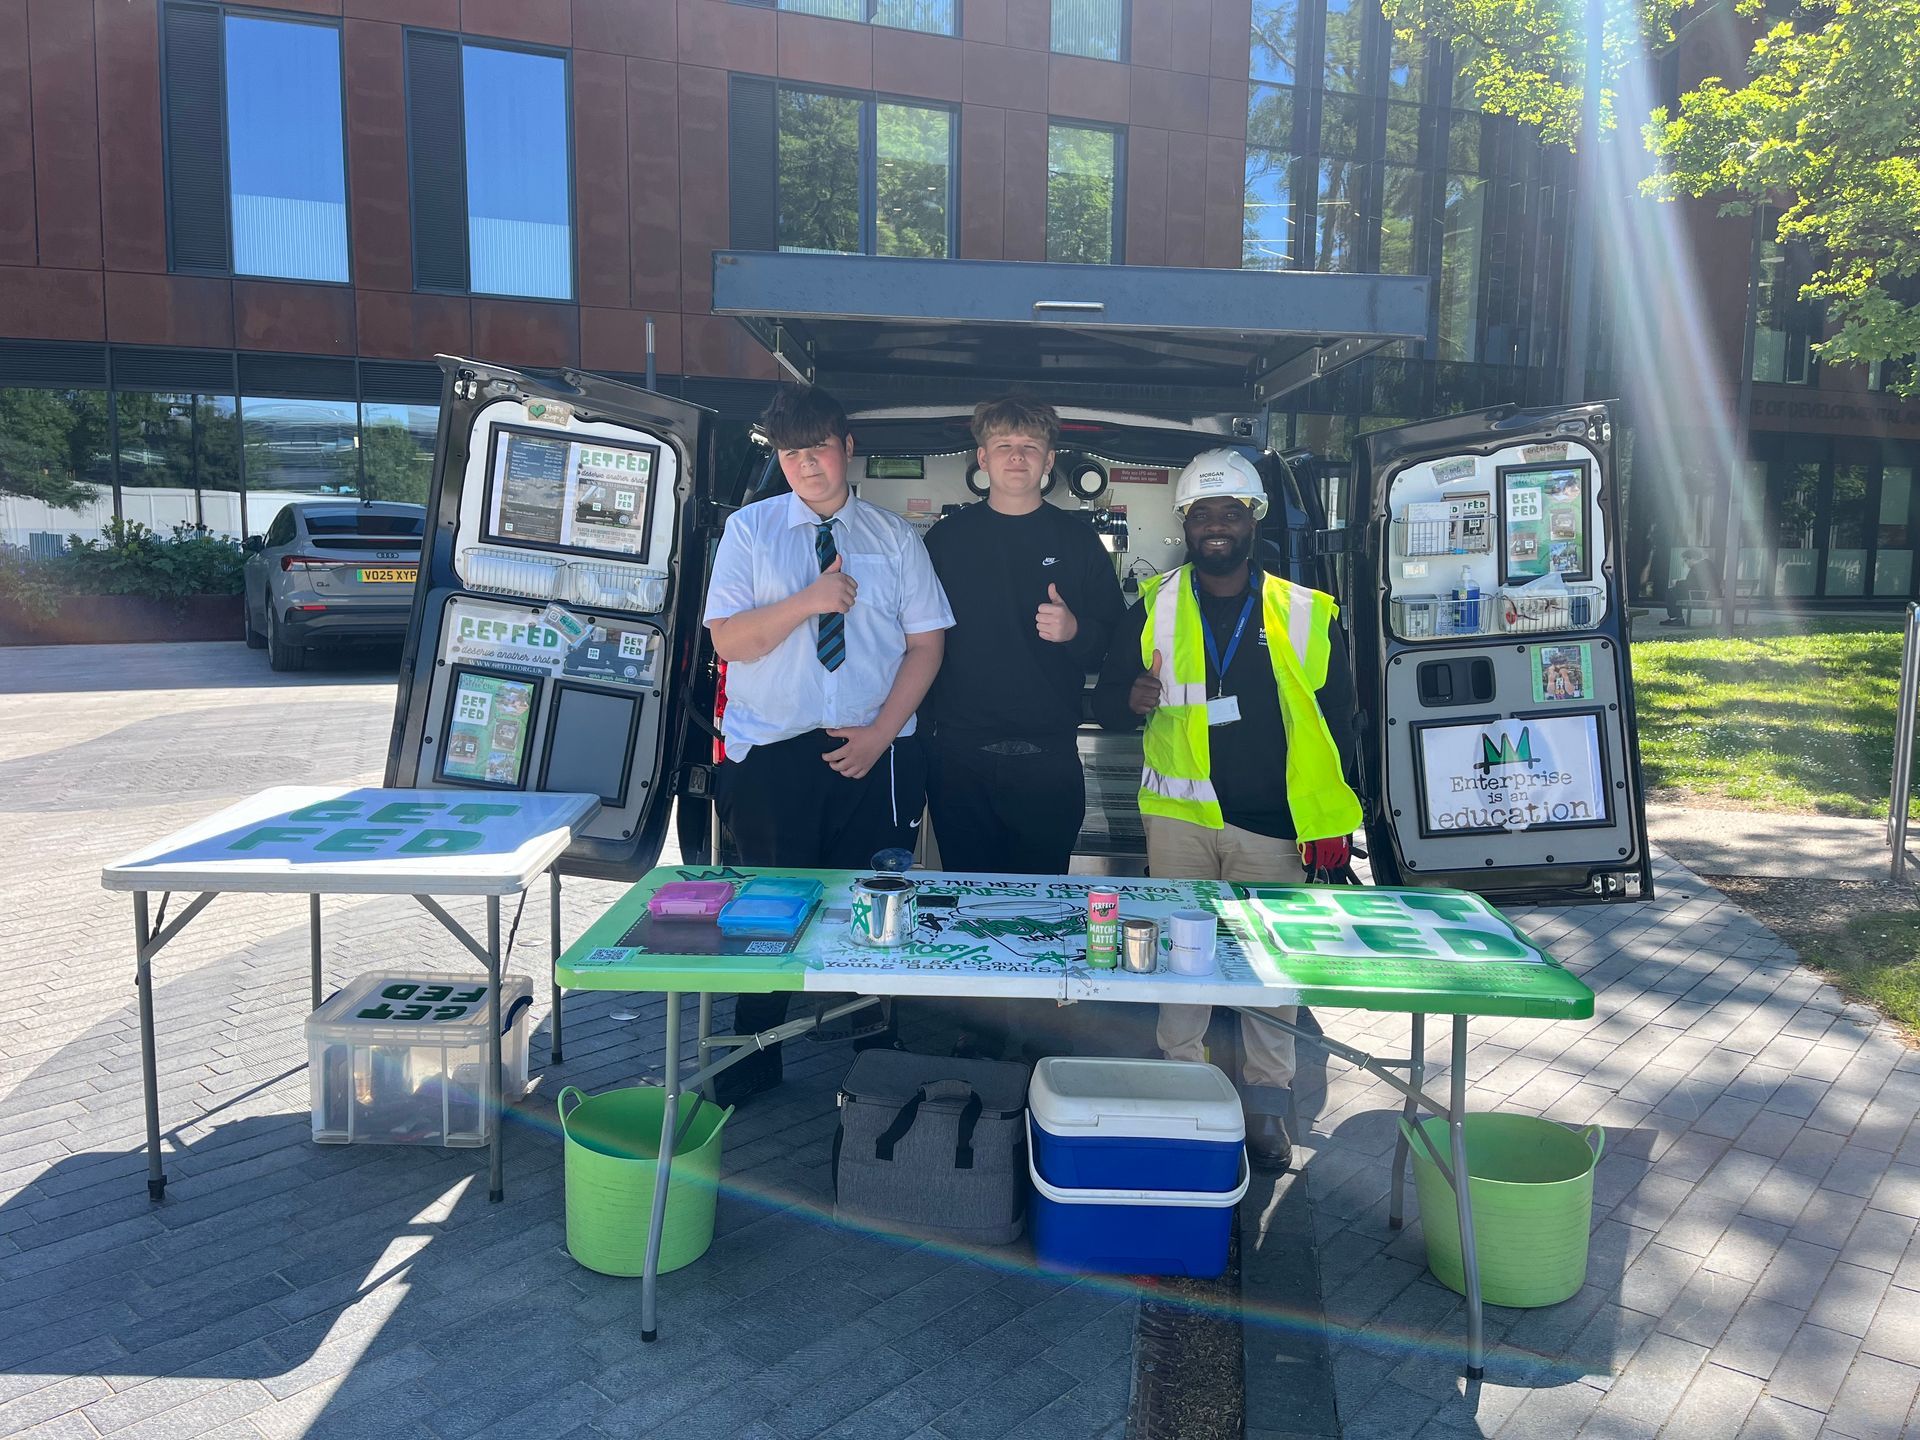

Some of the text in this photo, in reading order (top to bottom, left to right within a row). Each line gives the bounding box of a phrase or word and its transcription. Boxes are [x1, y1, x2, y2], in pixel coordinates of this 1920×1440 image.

[580, 449, 649, 472] GET FED
[1512, 492, 1537, 504] GET
[1512, 505, 1538, 517] FED
[364, 570, 417, 581] VO25 XYP
[460, 617, 508, 641] GET
[511, 624, 558, 647] FED
[624, 636, 644, 646] GET
[461, 646, 552, 665] deserve another shot
[623, 646, 642, 656] FED
[462, 695, 487, 708] GET
[459, 707, 485, 720] FED
[1450, 770, 1572, 793] Enterprise
[1488, 791, 1529, 805] is an
[288, 800, 522, 825] GET
[1438, 801, 1591, 828] education
[227, 826, 486, 853] FED
[914, 887, 1037, 897] USINESS
[988, 881, 1042, 889] NEXT
[1049, 883, 1179, 894] GENATION
[1091, 902, 1116, 911] PERFECT
[1256, 890, 1480, 923] GET
[1089, 923, 1117, 934] MATCHA
[1091, 934, 1114, 944] LATTE
[1273, 922, 1530, 958] FED
[905, 943, 993, 962] 100%
[825, 961, 895, 970] Young
[381, 984, 488, 1003] FED
[356, 1002, 469, 1021] GET
